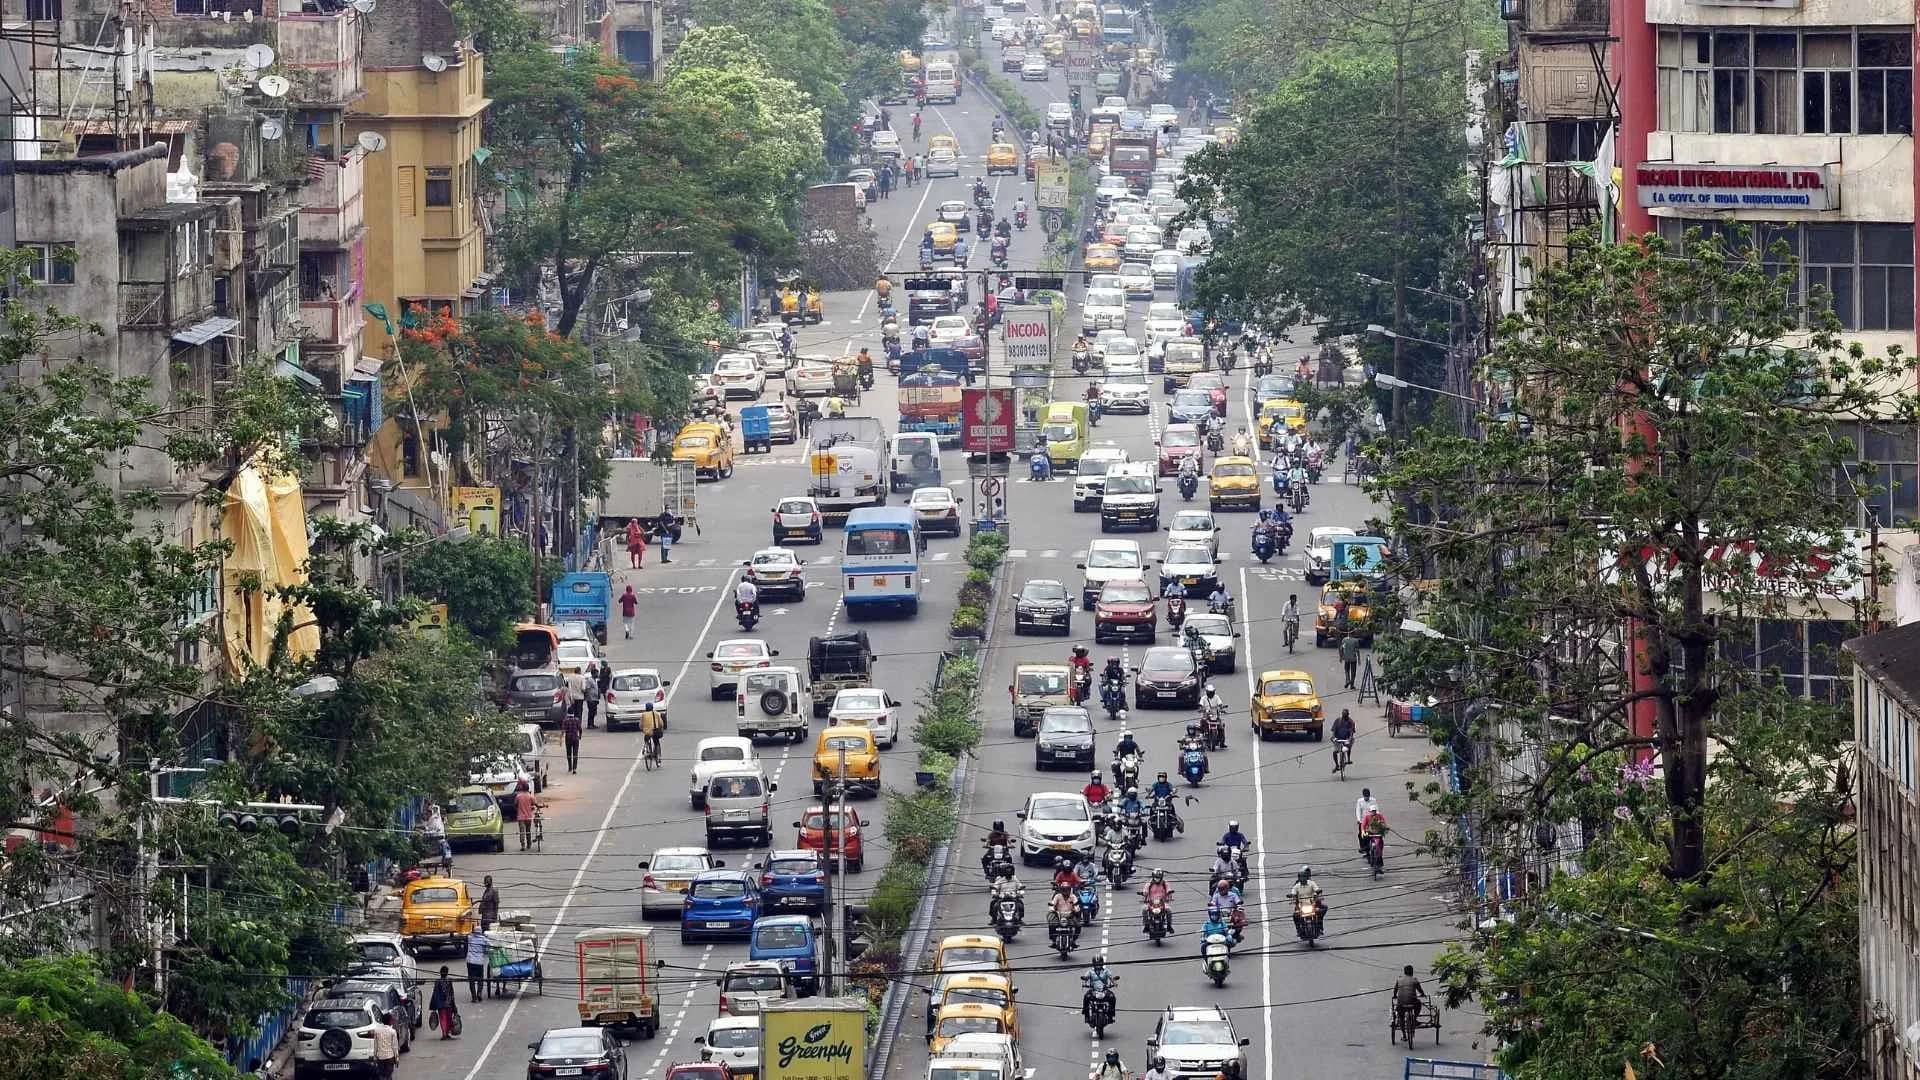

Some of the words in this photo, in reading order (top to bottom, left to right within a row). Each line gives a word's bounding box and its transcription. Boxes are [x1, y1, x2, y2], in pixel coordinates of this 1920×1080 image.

[1681, 170, 1791, 189] INTERNATIONAL
[1792, 171, 1825, 190] LTD.
[1698, 194, 1711, 204] OF
[1714, 194, 1739, 204] INDIA
[1007, 319, 1047, 338] INCODA
[637, 585, 718, 595] STOP
[778, 1035, 853, 1068] Greenply
